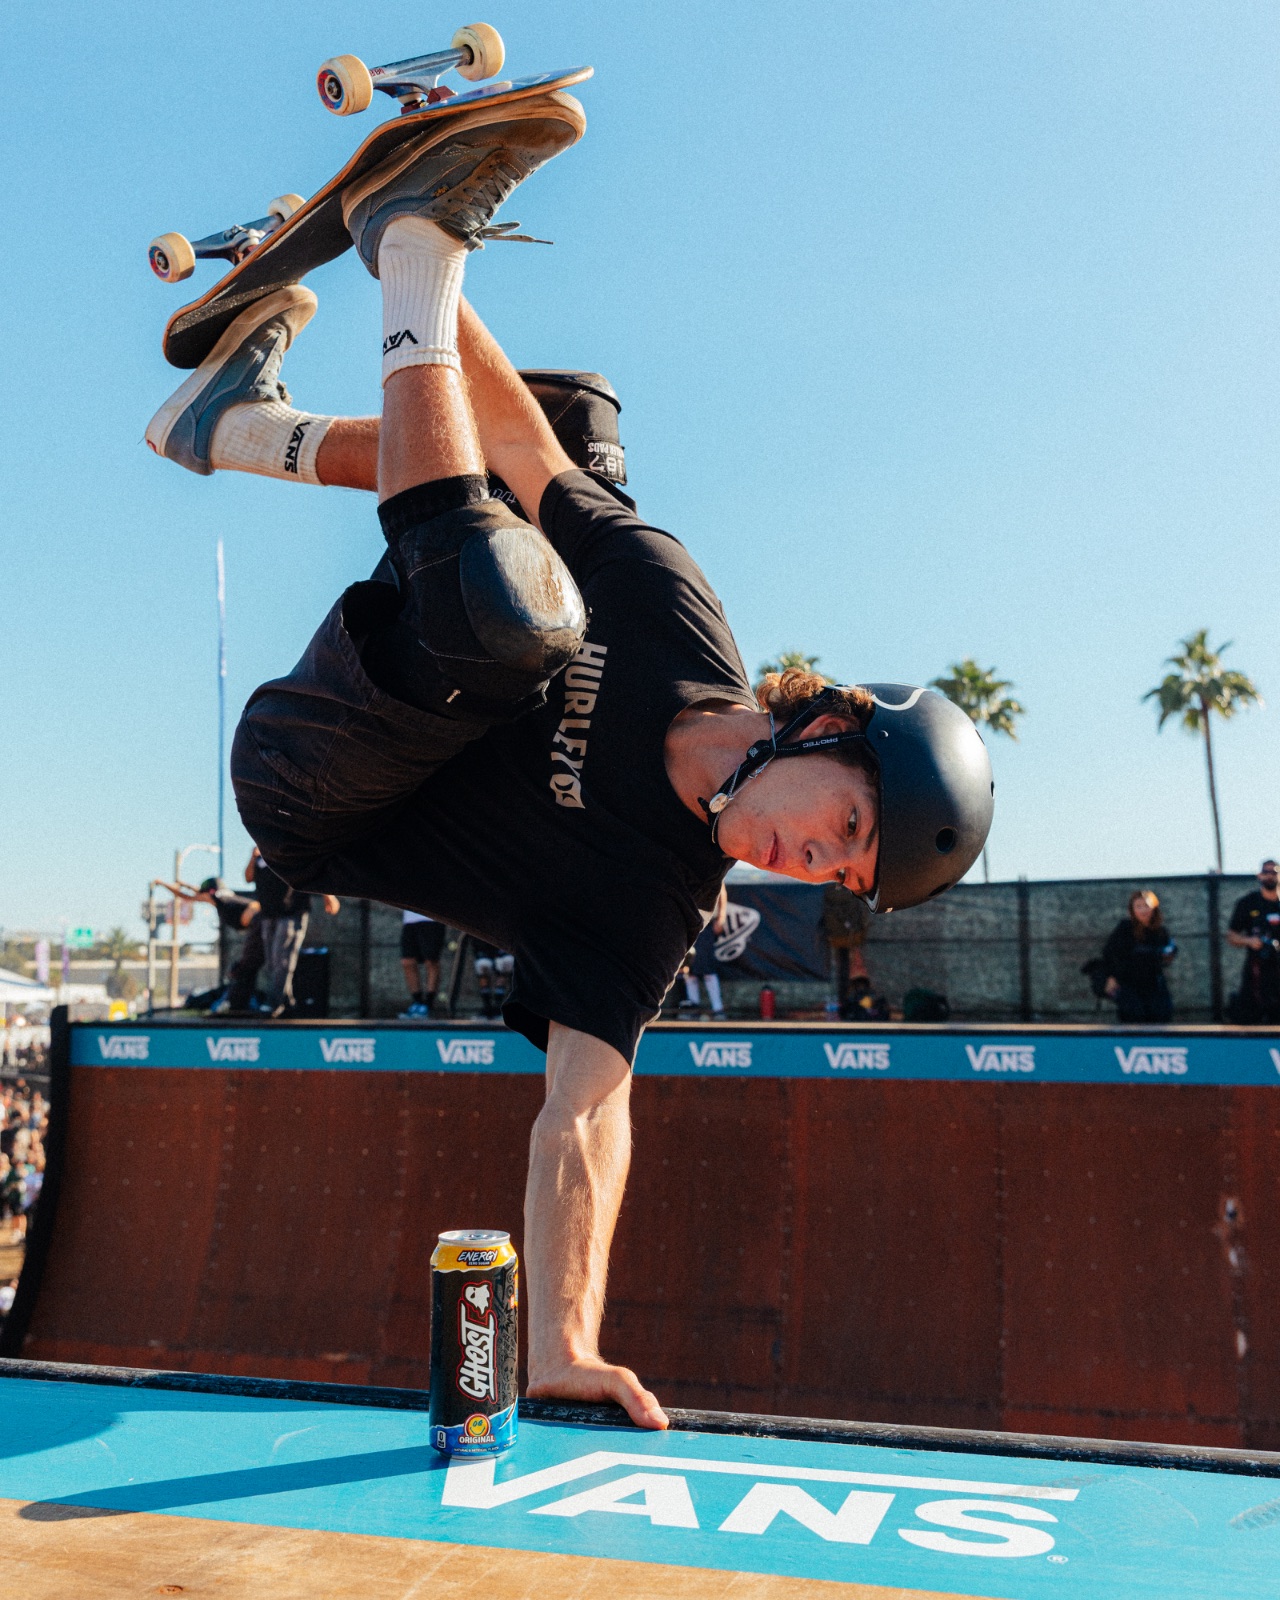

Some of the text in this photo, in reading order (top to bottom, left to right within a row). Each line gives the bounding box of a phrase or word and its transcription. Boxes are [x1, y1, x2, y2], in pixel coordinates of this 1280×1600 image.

[284, 421, 310, 474] VANS
[587, 442, 609, 453] PADS
[98, 1035, 150, 1060] VANS
[206, 1037, 260, 1061] VANS
[319, 1038, 376, 1063] VANS
[436, 1039, 495, 1065] VANS
[689, 1041, 752, 1068] VANS
[823, 1043, 890, 1070] VANS
[965, 1044, 1035, 1072] VANS
[1114, 1046, 1188, 1075] VANS
[458, 1250, 498, 1262] ENERGY
[459, 1302, 495, 1400] GHOST
[459, 1435, 495, 1444] ORIGINAL
[442, 1451, 1079, 1558] VANS
